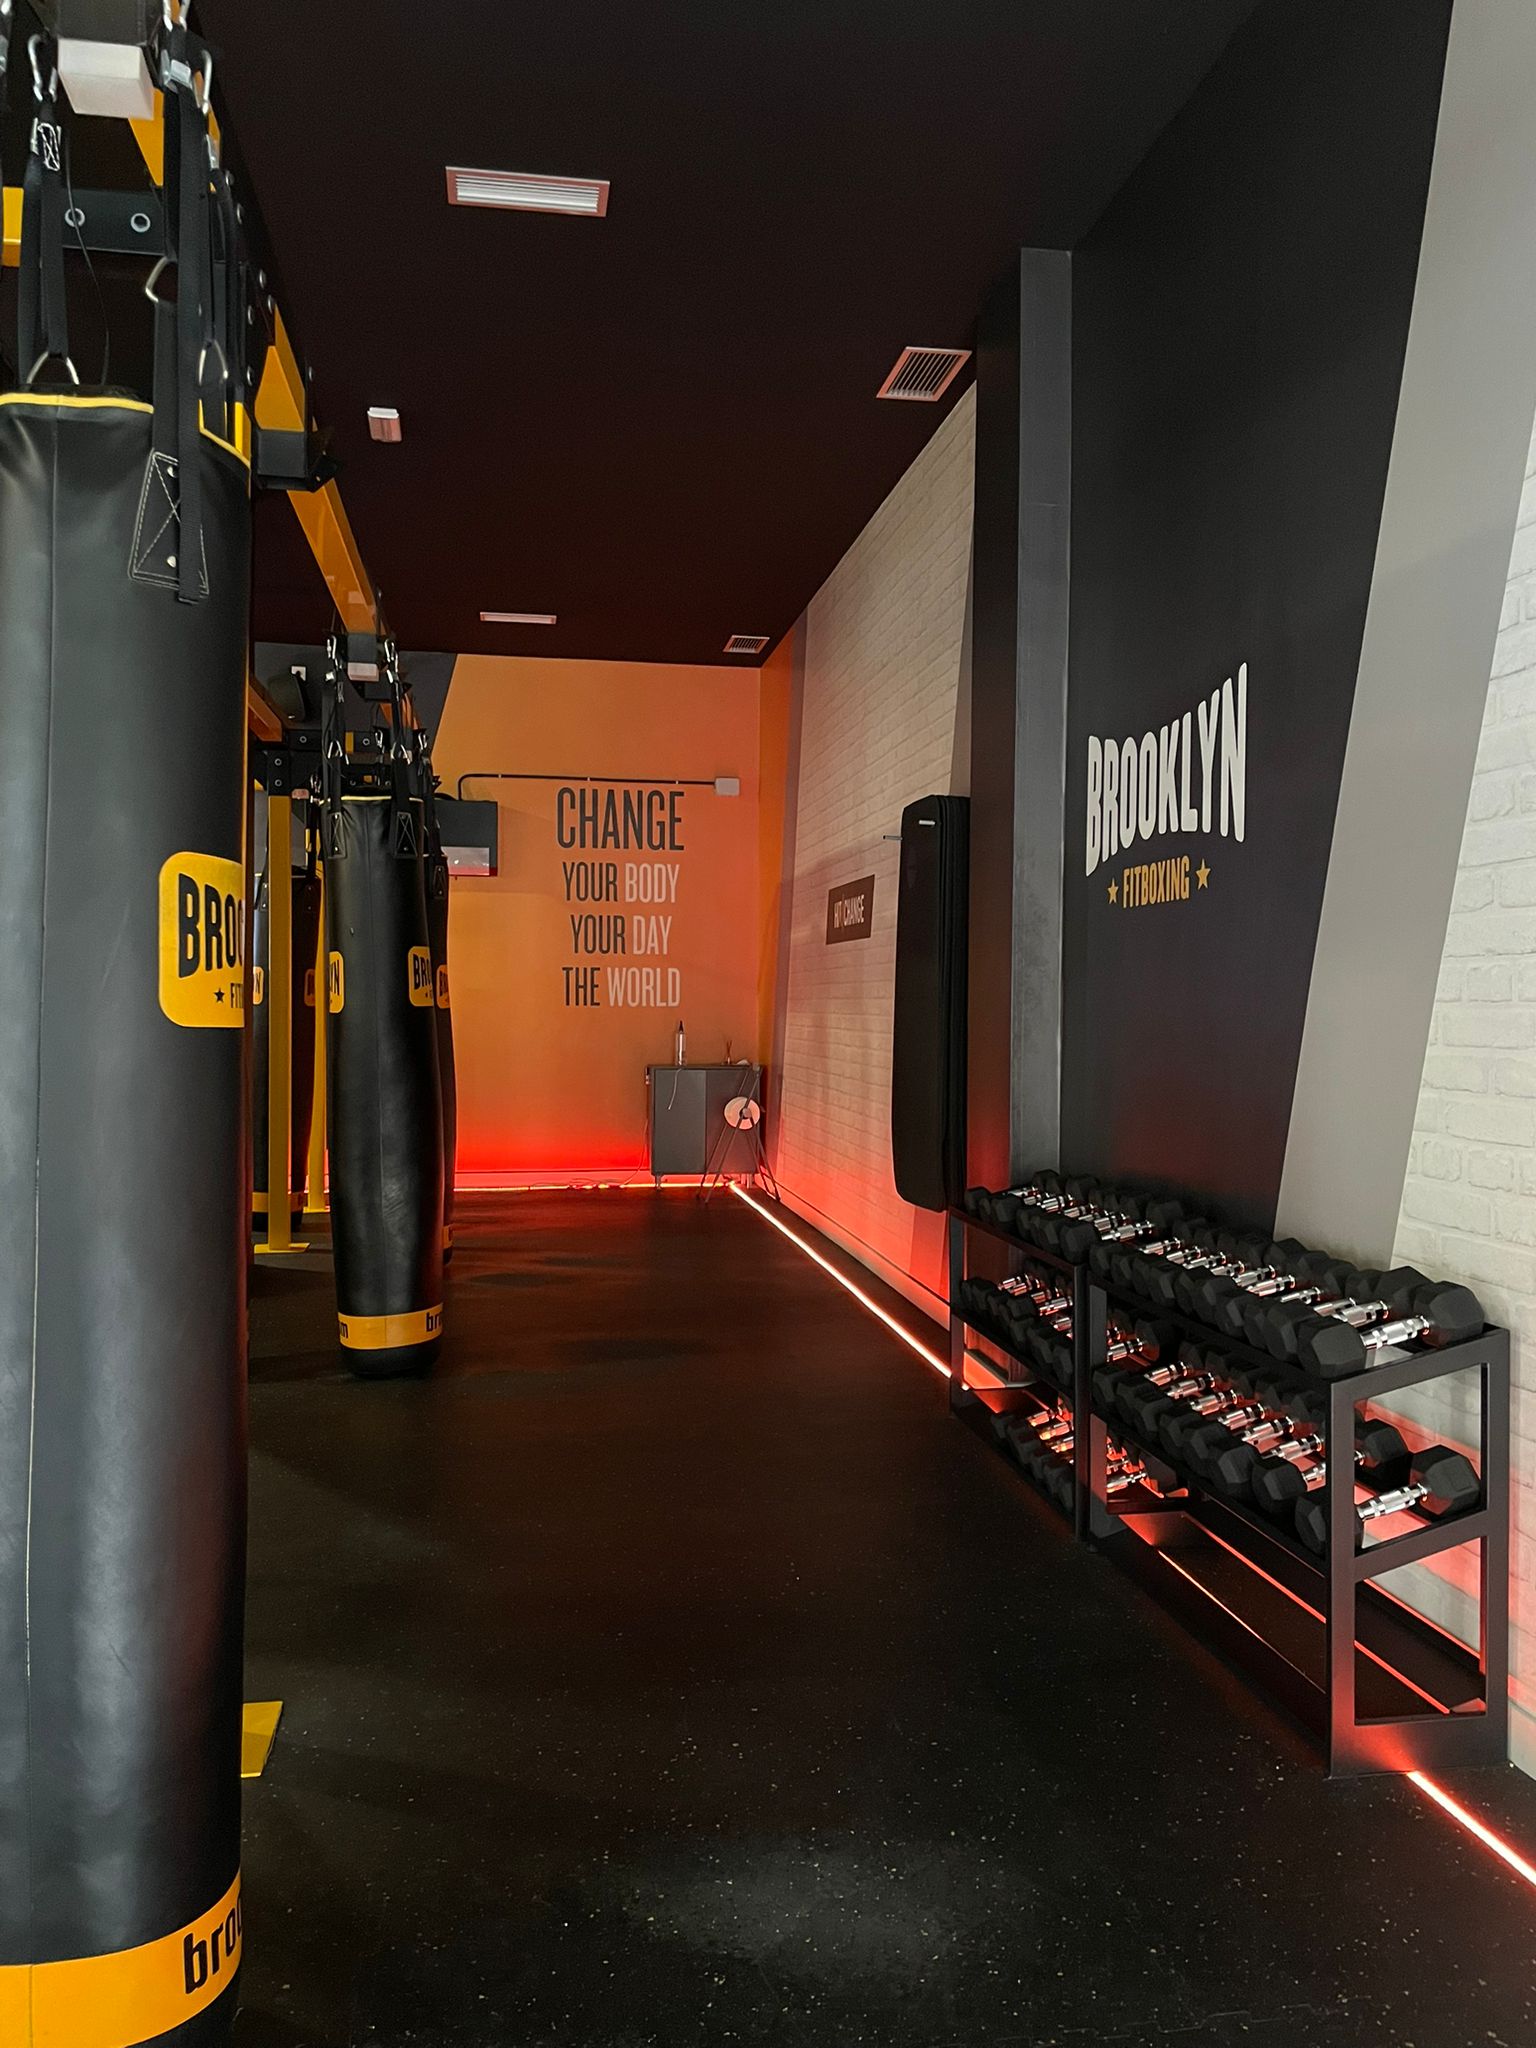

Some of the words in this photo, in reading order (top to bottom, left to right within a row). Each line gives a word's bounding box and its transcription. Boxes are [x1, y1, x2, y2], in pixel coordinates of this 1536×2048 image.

[1086, 662, 1247, 877] BROOKLYN
[557, 787, 684, 851] CHANGE
[562, 861, 618, 902] YOUR
[625, 863, 680, 903] BODY
[1123, 855, 1189, 908] FITBOXING
[570, 914, 626, 955] YOUR
[632, 915, 672, 955] DAY
[562, 967, 601, 1007] THE
[607, 967, 681, 1008] WORLD
